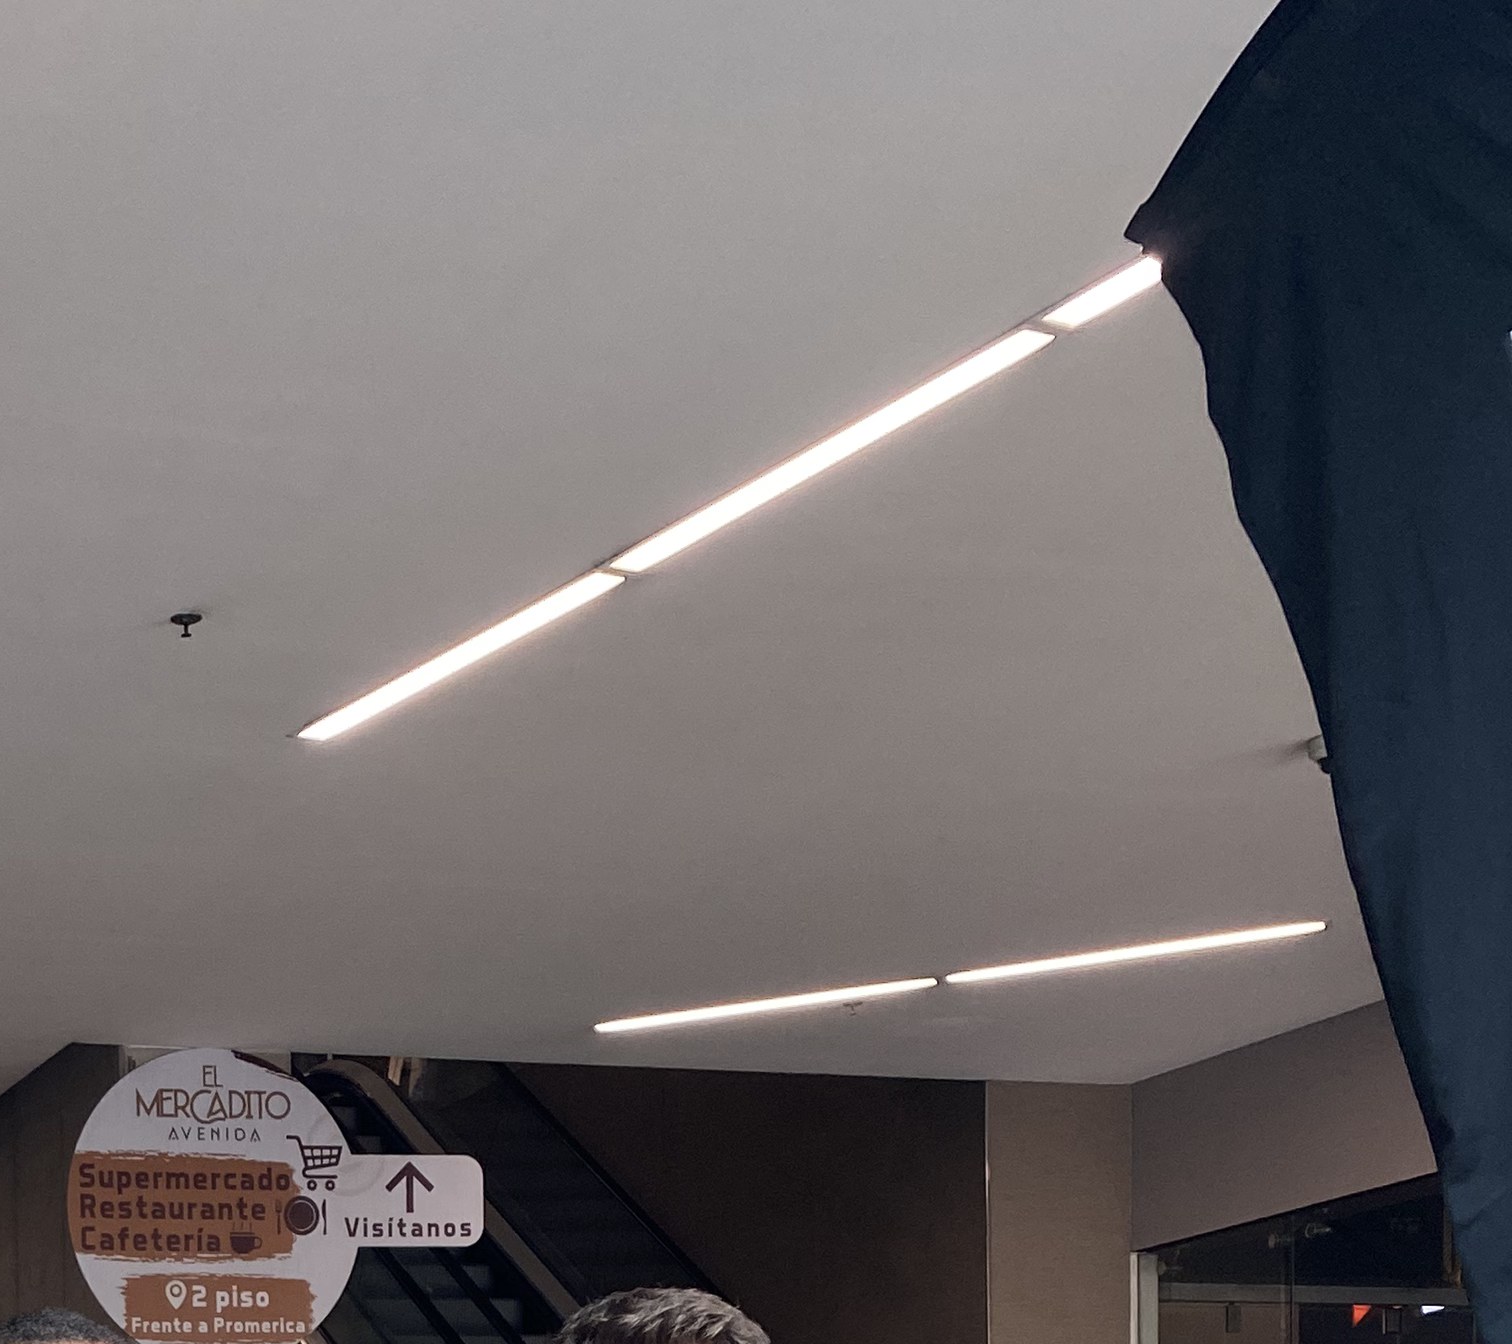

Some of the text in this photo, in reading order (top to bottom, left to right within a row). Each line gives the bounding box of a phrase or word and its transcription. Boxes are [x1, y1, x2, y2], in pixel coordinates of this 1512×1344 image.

[202, 1065, 223, 1088] EL
[135, 1088, 292, 1124] MERCADITO
[168, 1127, 262, 1142] AVENIDA
[78, 1163, 290, 1194] Supermercado
[80, 1194, 267, 1221] Restaurante
[80, 1226, 222, 1253] Cafetería
[344, 1216, 473, 1238] Visítanos
[191, 1285, 270, 1313] 2 piso
[131, 1317, 306, 1334] Frente a Promerica
